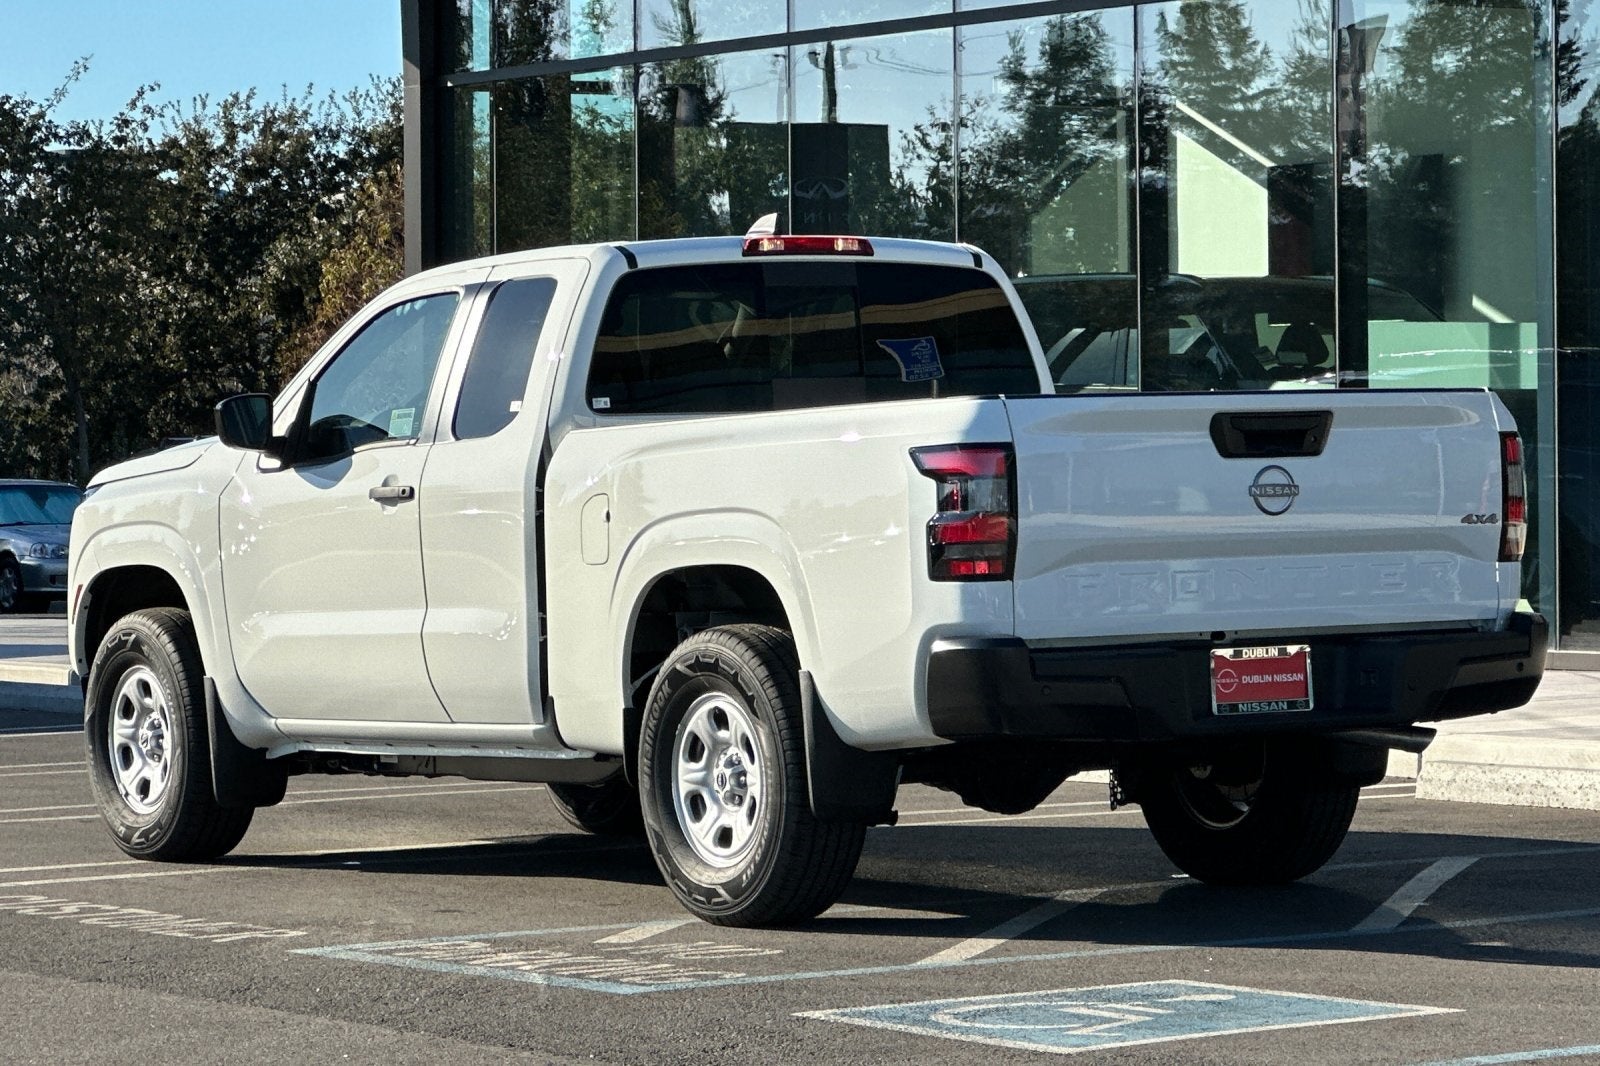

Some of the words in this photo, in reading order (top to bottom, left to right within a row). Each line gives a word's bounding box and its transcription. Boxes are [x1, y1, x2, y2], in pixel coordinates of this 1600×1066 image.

[1251, 485, 1299, 496] NISSAN
[1062, 561, 1462, 606] FRONTIER
[1242, 647, 1279, 659] DUBLIN
[1241, 674, 1272, 684] DUBLIN
[1273, 673, 1304, 682] NISSAN
[1238, 701, 1288, 713] NISSAN
